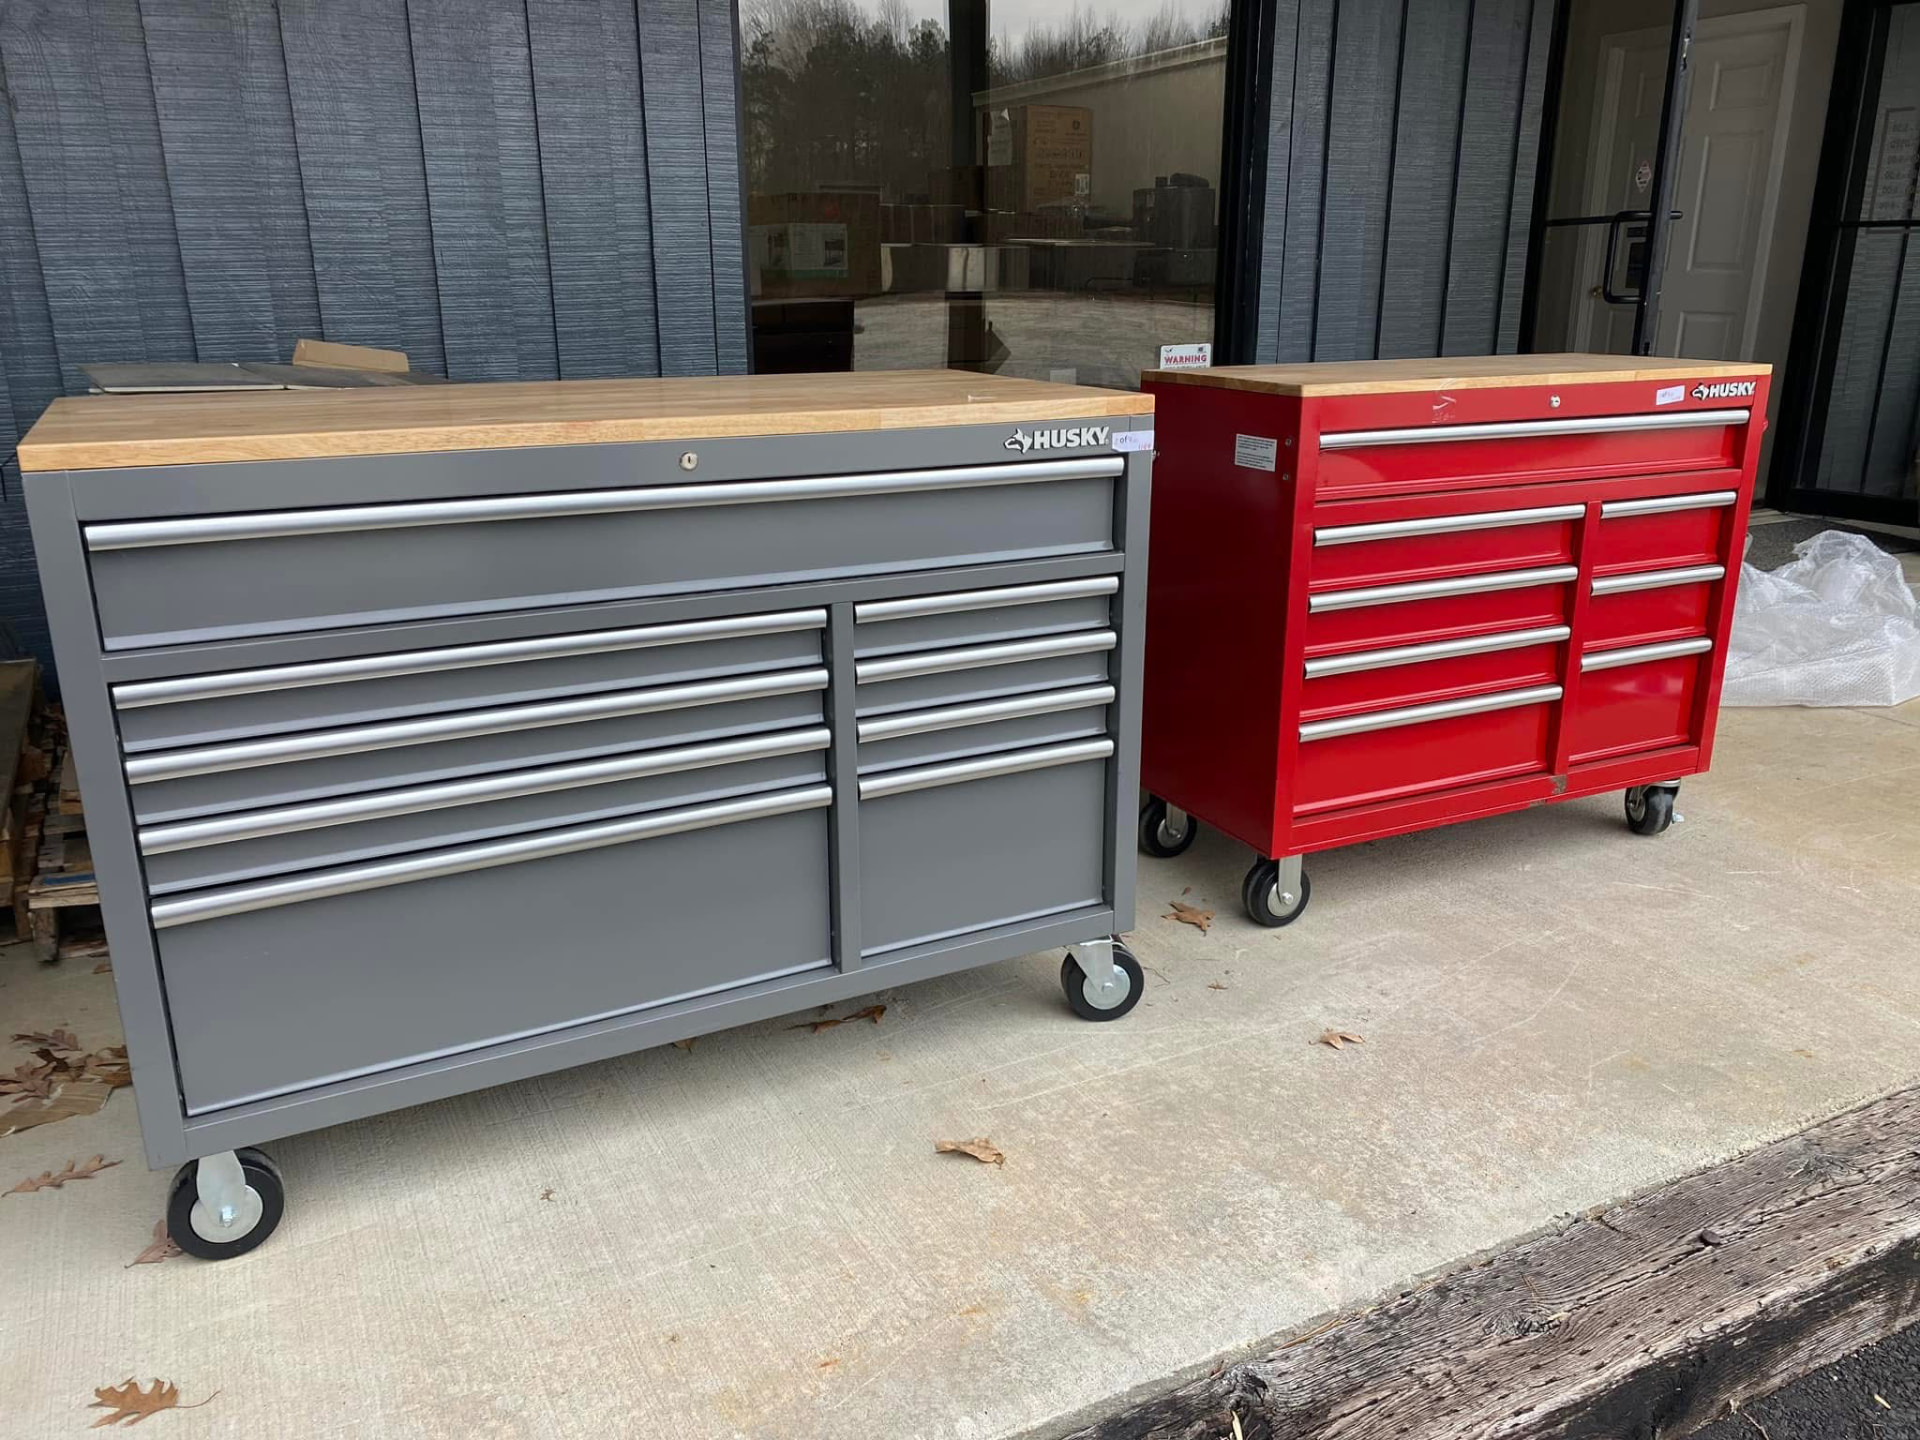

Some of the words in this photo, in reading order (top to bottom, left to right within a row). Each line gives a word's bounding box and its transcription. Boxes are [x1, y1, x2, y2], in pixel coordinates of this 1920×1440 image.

[1164, 354, 1207, 364] WARNING
[1709, 382, 1756, 398] HUSKY
[1033, 426, 1110, 450] HUSKY
